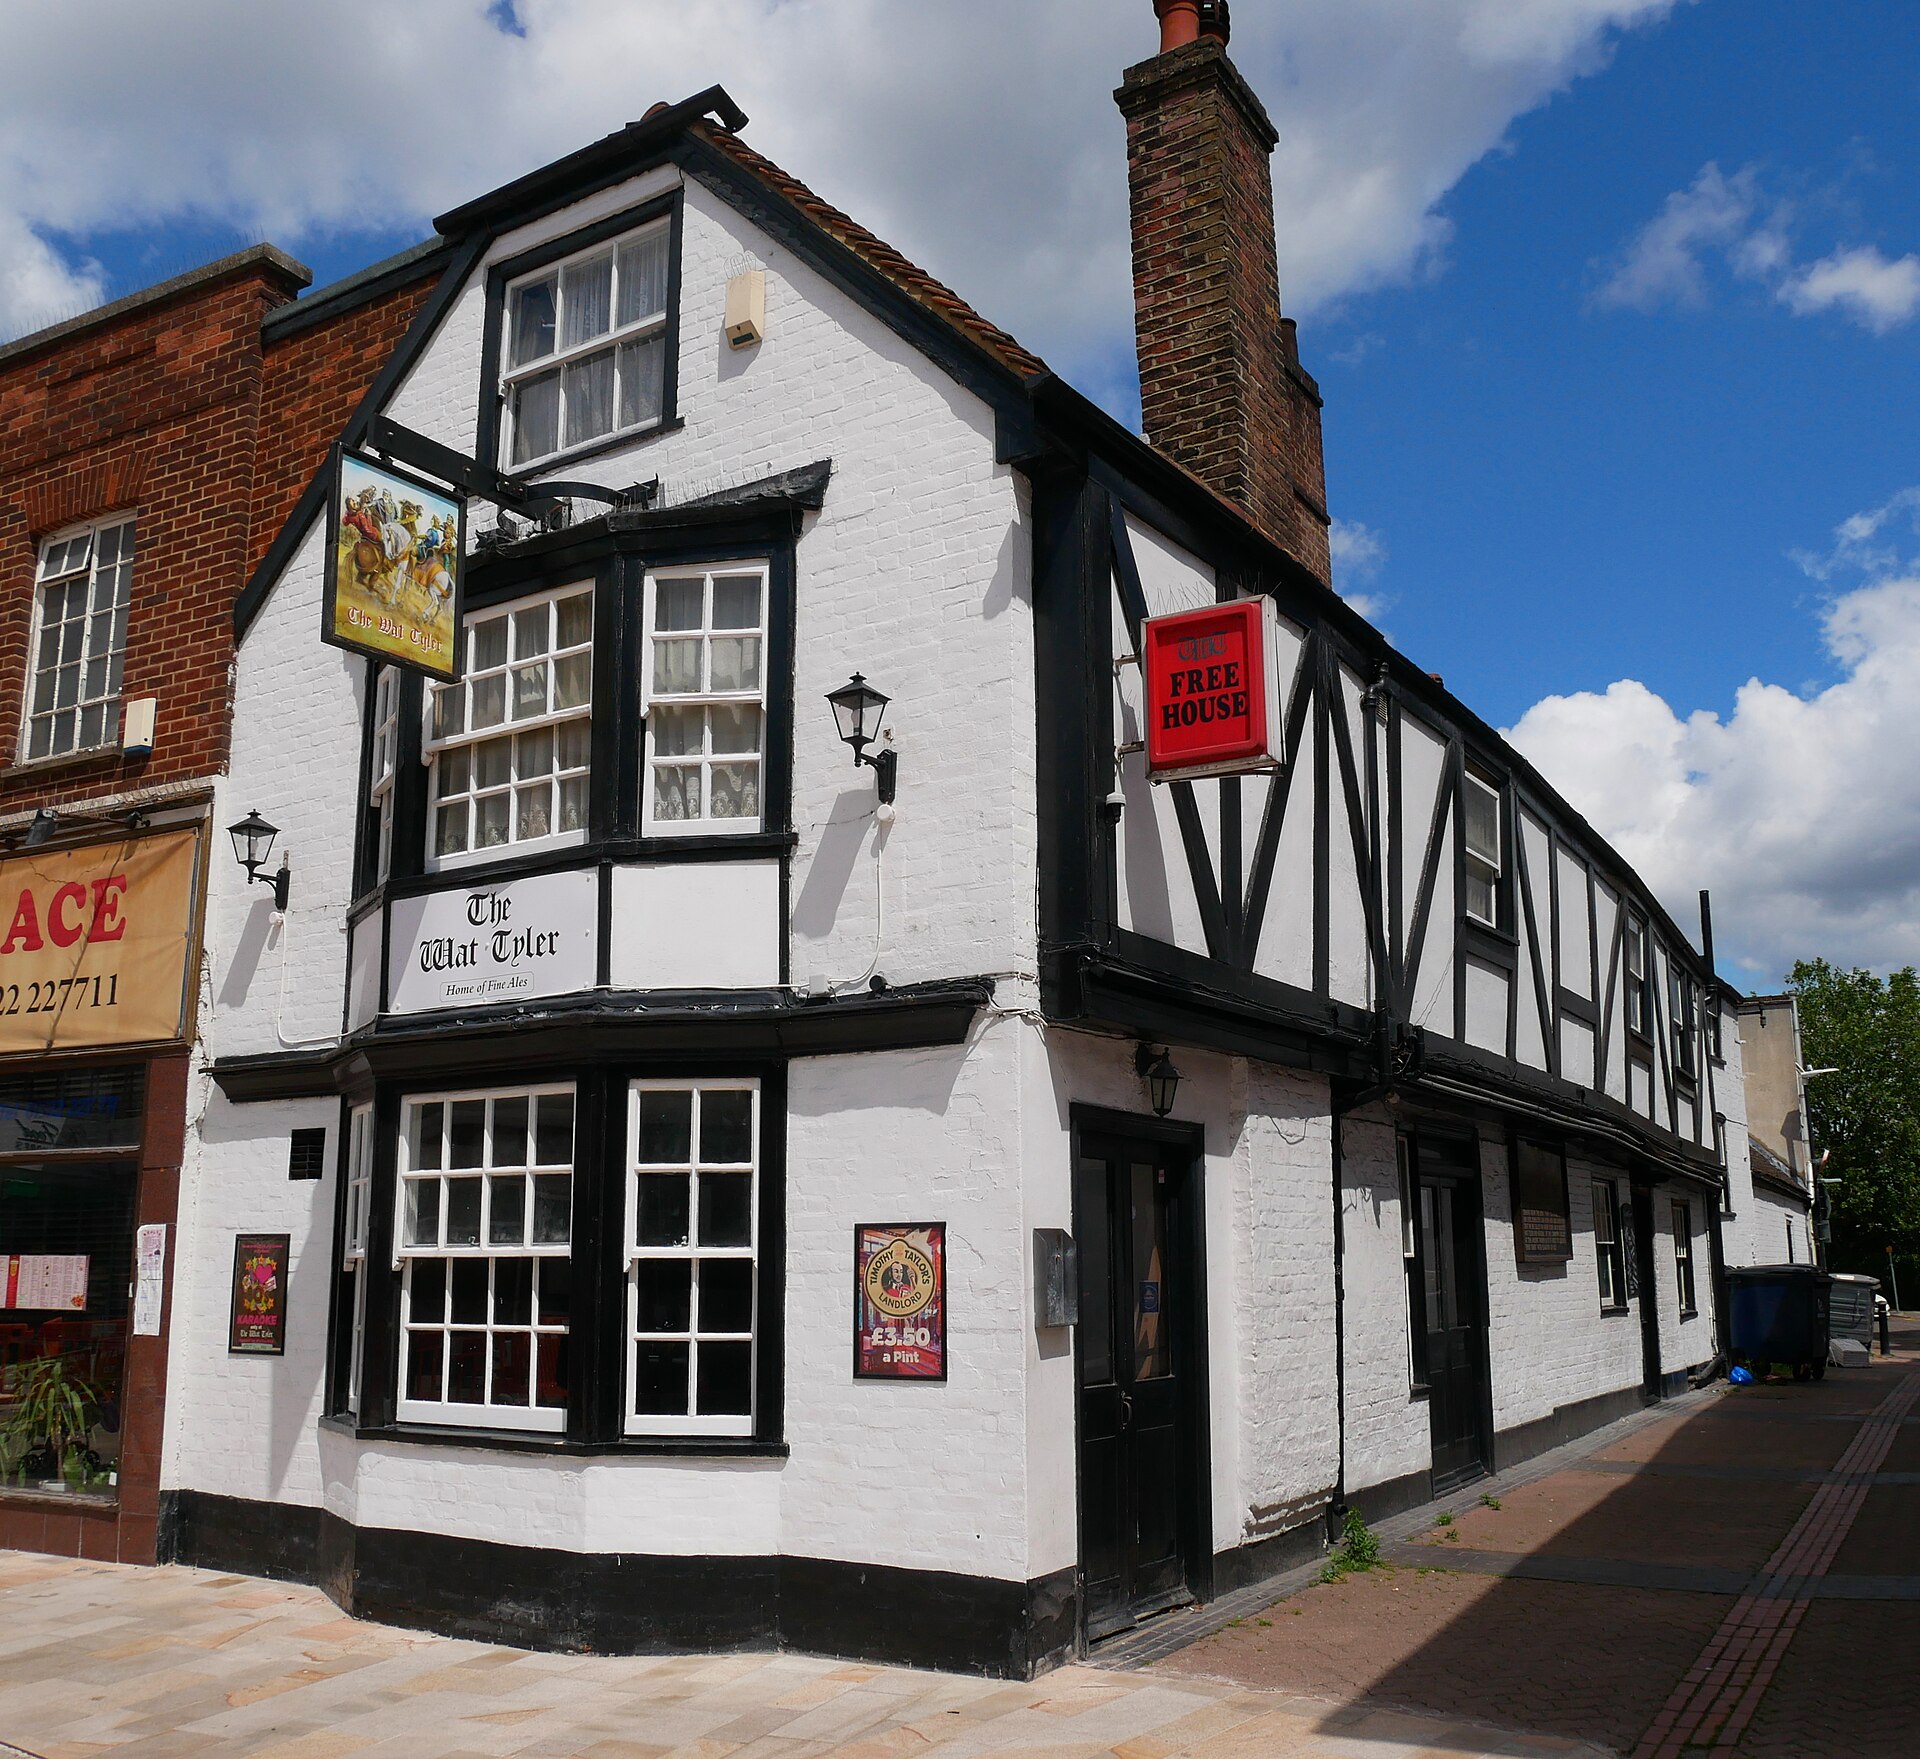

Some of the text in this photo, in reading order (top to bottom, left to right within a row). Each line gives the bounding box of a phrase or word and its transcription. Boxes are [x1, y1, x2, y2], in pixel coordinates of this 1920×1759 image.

[347, 607, 442, 653] The Wat Tyler
[1170, 662, 1240, 698] FREE
[1161, 691, 1248, 730] HOUSE
[0, 874, 127, 954] ACE
[466, 892, 511, 928] The
[419, 926, 560, 973] Wat Tyler
[26, 974, 118, 1013] 227711
[446, 976, 528, 996] Home of Fine Ales
[870, 1250, 931, 1285] TIMOTHY TAYLOR'S
[878, 1291, 922, 1309] LANDLORD
[236, 1314, 278, 1325] KARAOKE
[871, 1326, 931, 1347] £3.50
[882, 1351, 920, 1363] a Pint
